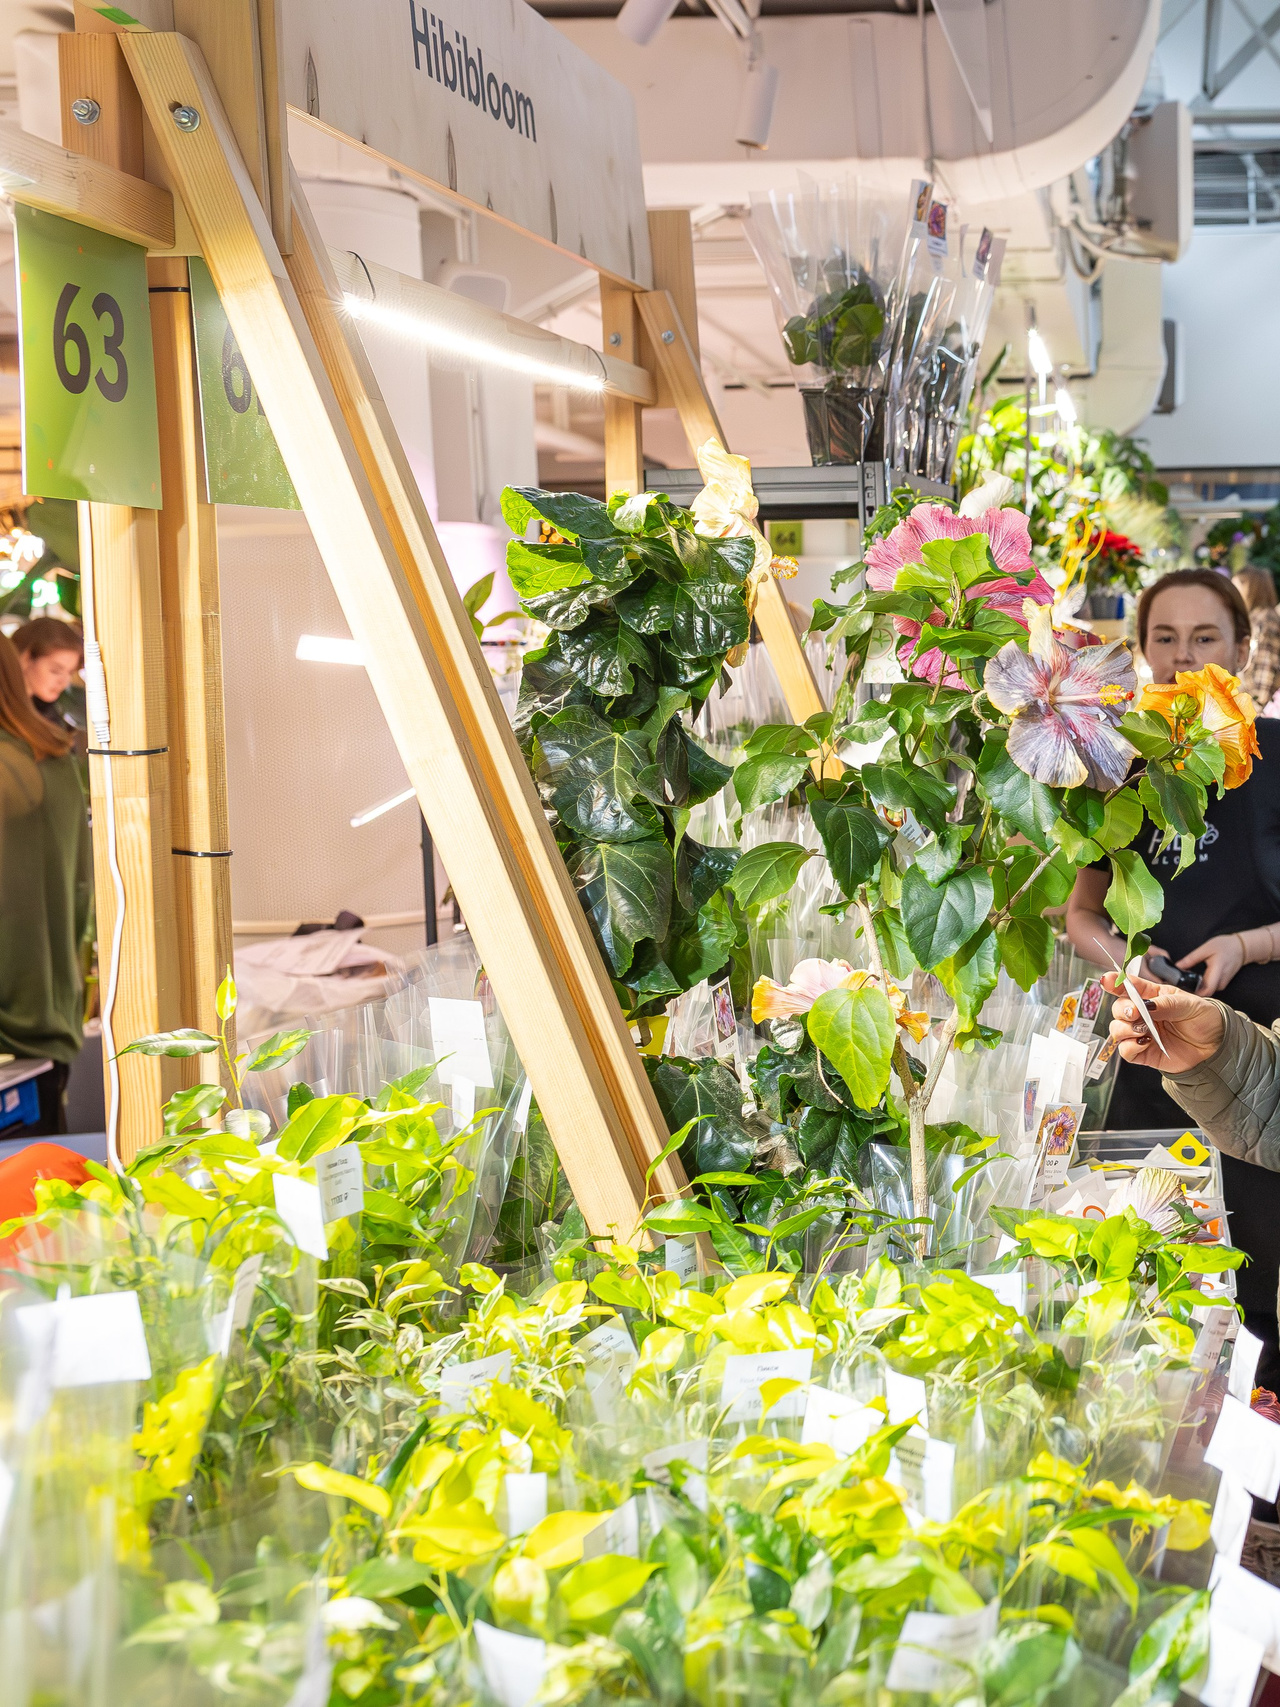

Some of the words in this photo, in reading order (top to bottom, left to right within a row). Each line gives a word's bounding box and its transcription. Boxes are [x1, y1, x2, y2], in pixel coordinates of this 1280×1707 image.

[409, 0, 537, 143] Hibibloom
[53, 282, 128, 403] 63
[222, 322, 266, 417] 6
